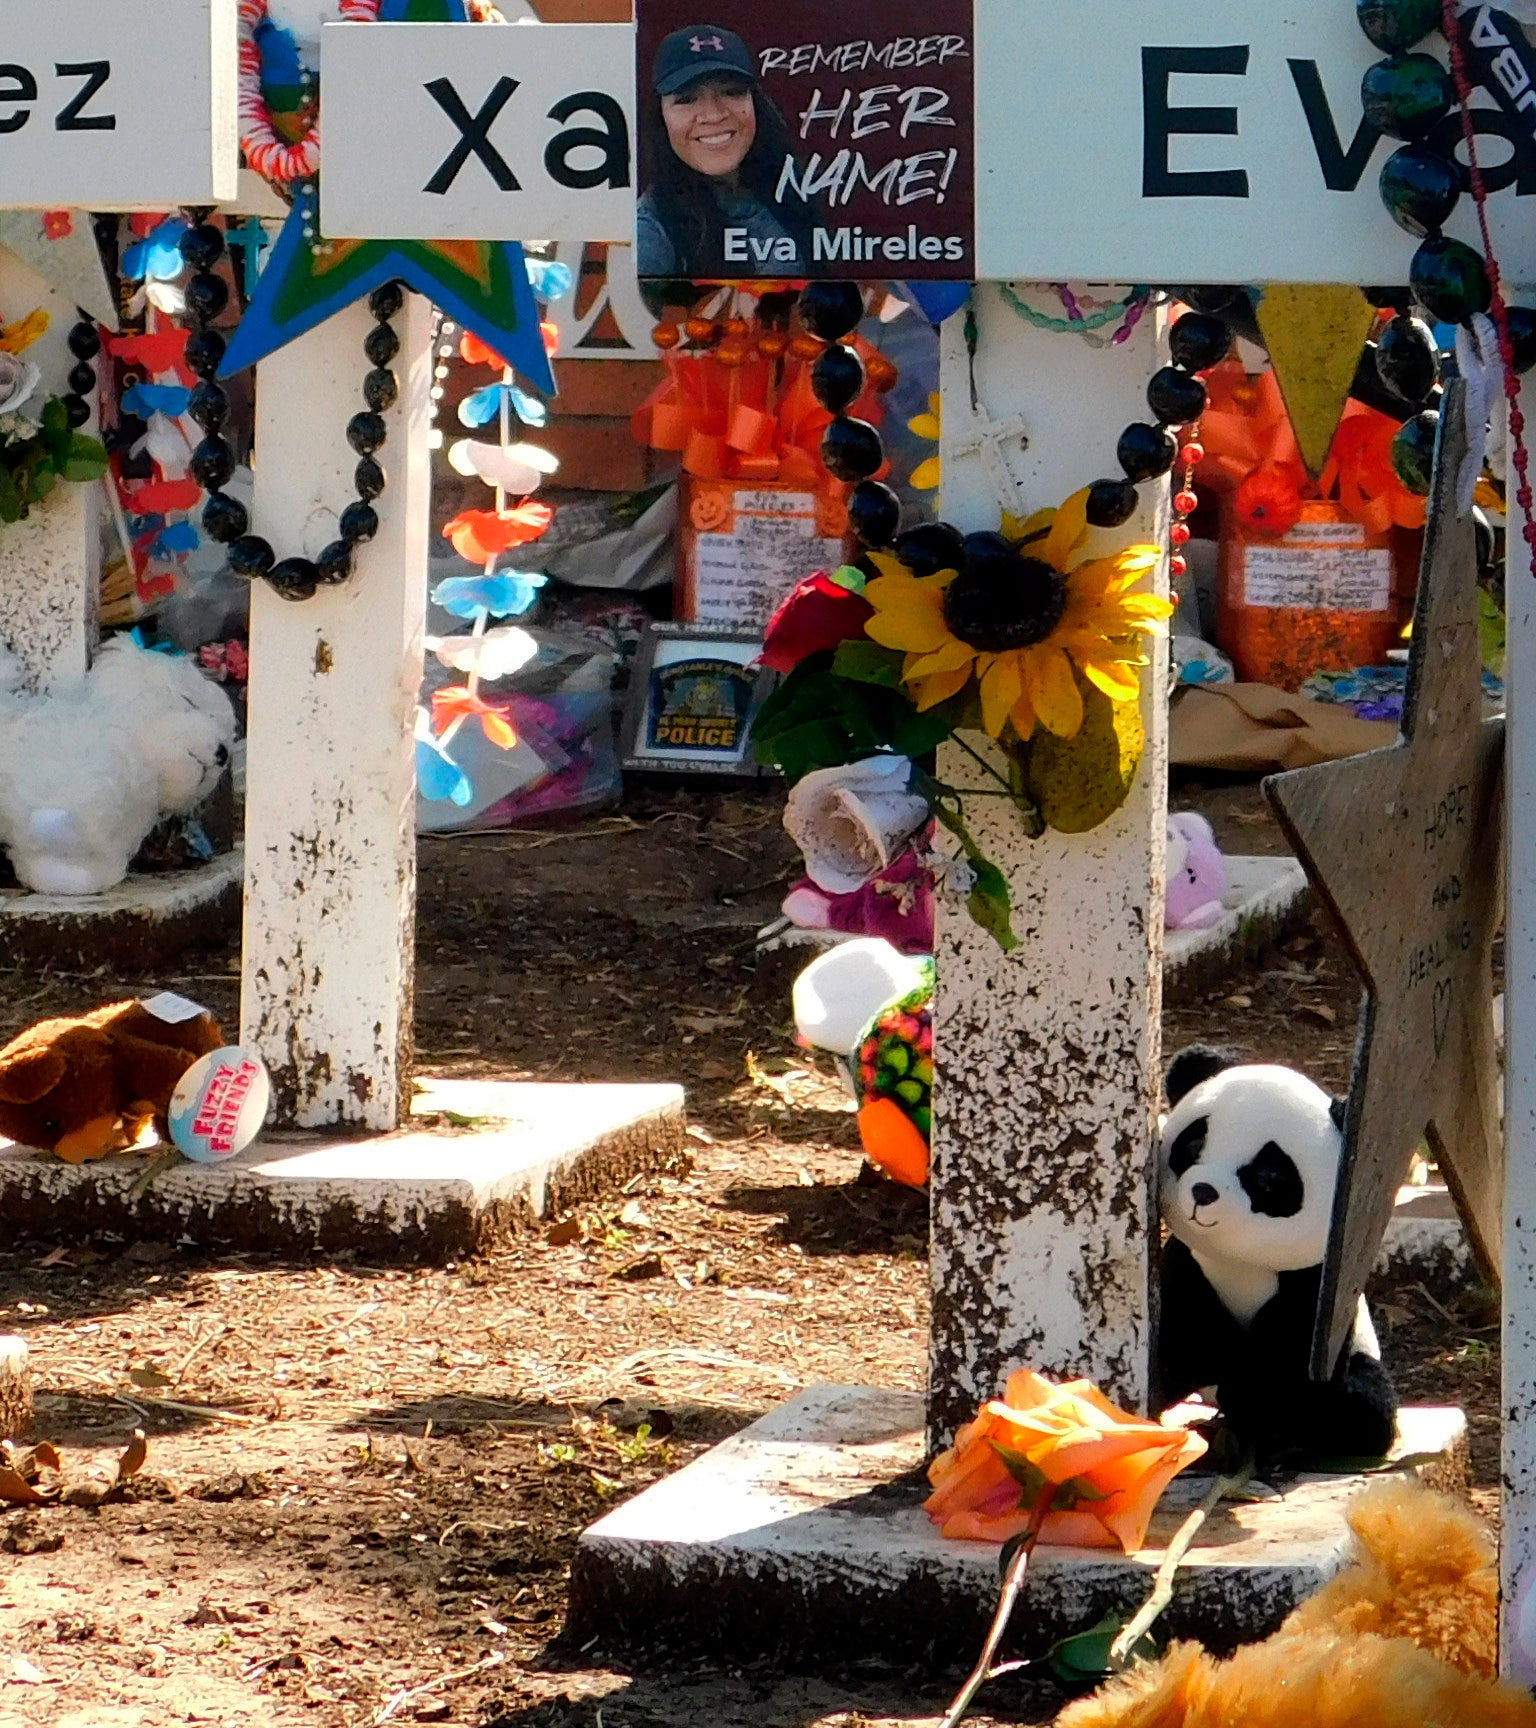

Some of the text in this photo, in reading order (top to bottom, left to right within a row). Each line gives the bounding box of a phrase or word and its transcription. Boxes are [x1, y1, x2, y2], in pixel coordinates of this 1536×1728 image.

[758, 35, 970, 77] REMEMBER
[798, 84, 956, 140] HER
[774, 148, 958, 208] NAME!
[723, 224, 964, 262] Eva Mireles
[655, 726, 736, 747] POLICE
[192, 1063, 236, 1136] FUZZY
[209, 1059, 261, 1153] FRIENDS
